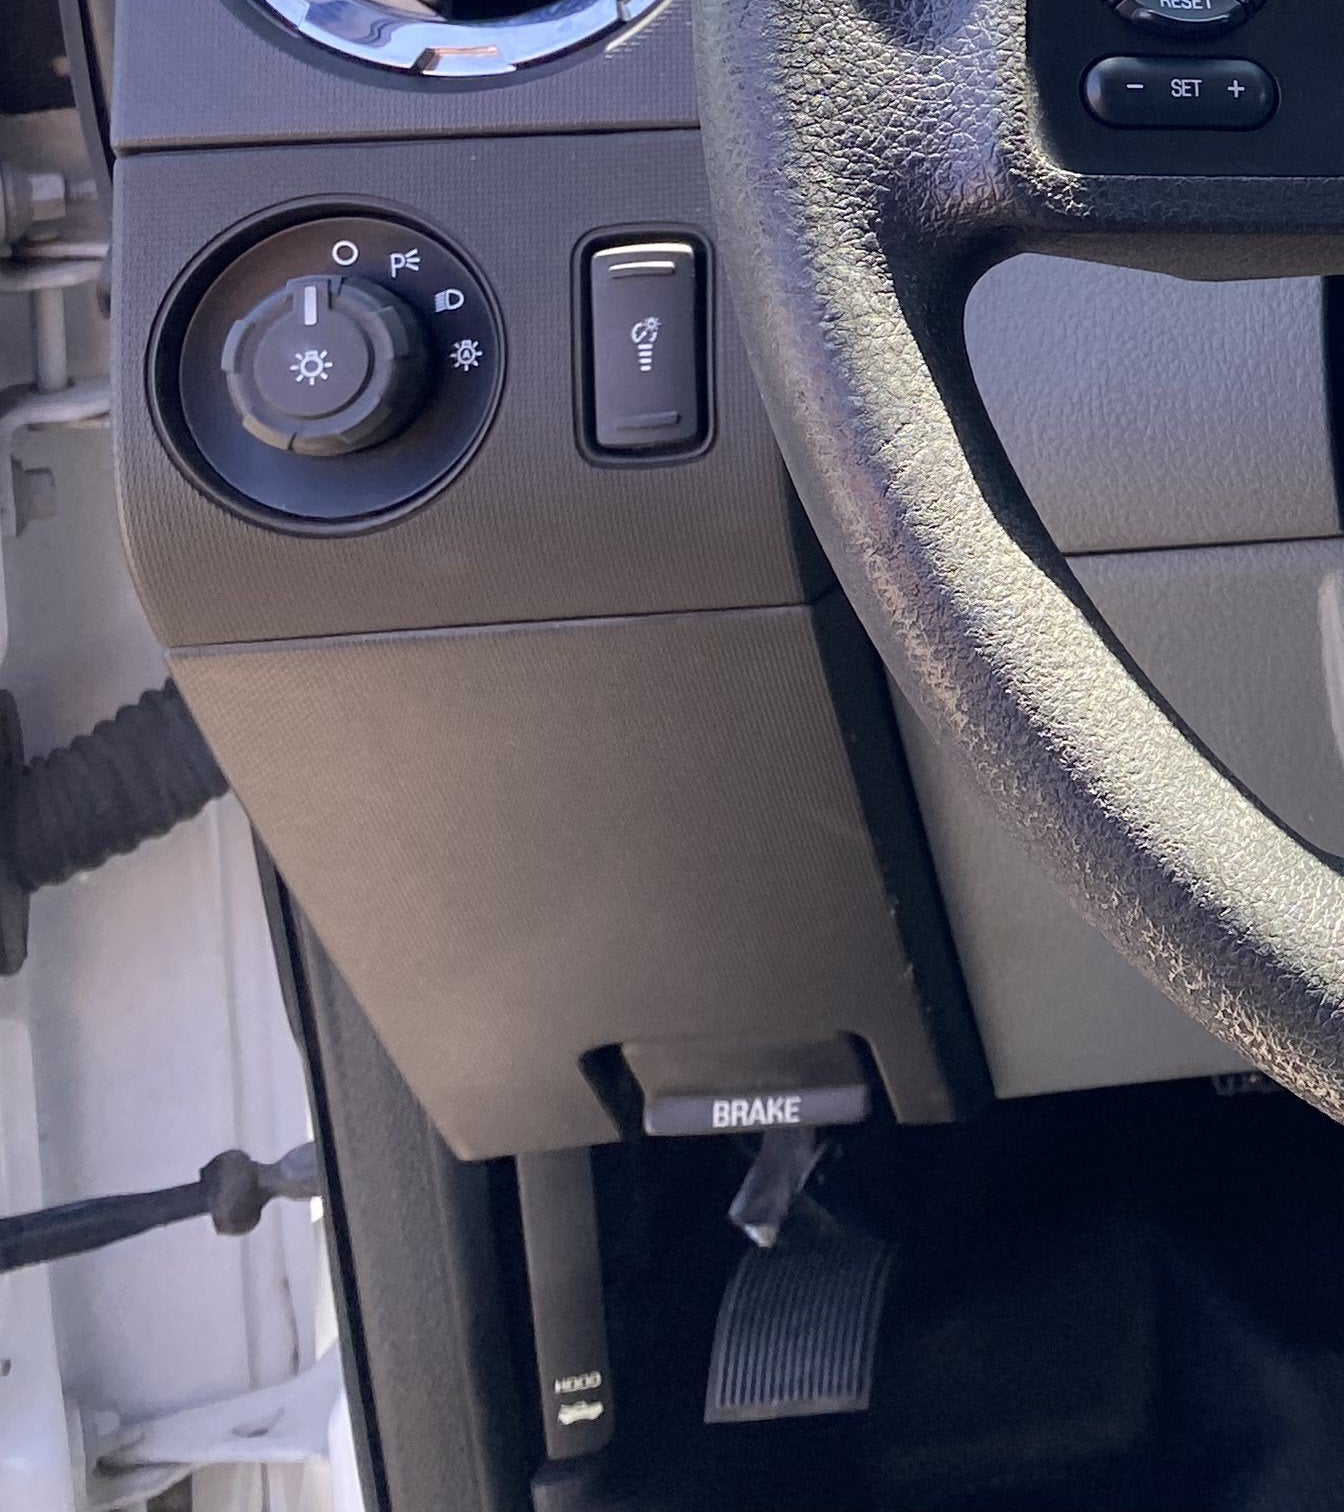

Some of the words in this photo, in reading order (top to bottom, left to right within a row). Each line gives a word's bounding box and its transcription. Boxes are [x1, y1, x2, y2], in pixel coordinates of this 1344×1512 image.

[1170, 79, 1202, 98] SET
[712, 1095, 802, 1129] BRAKE
[554, 1370, 602, 1394] HOOD
